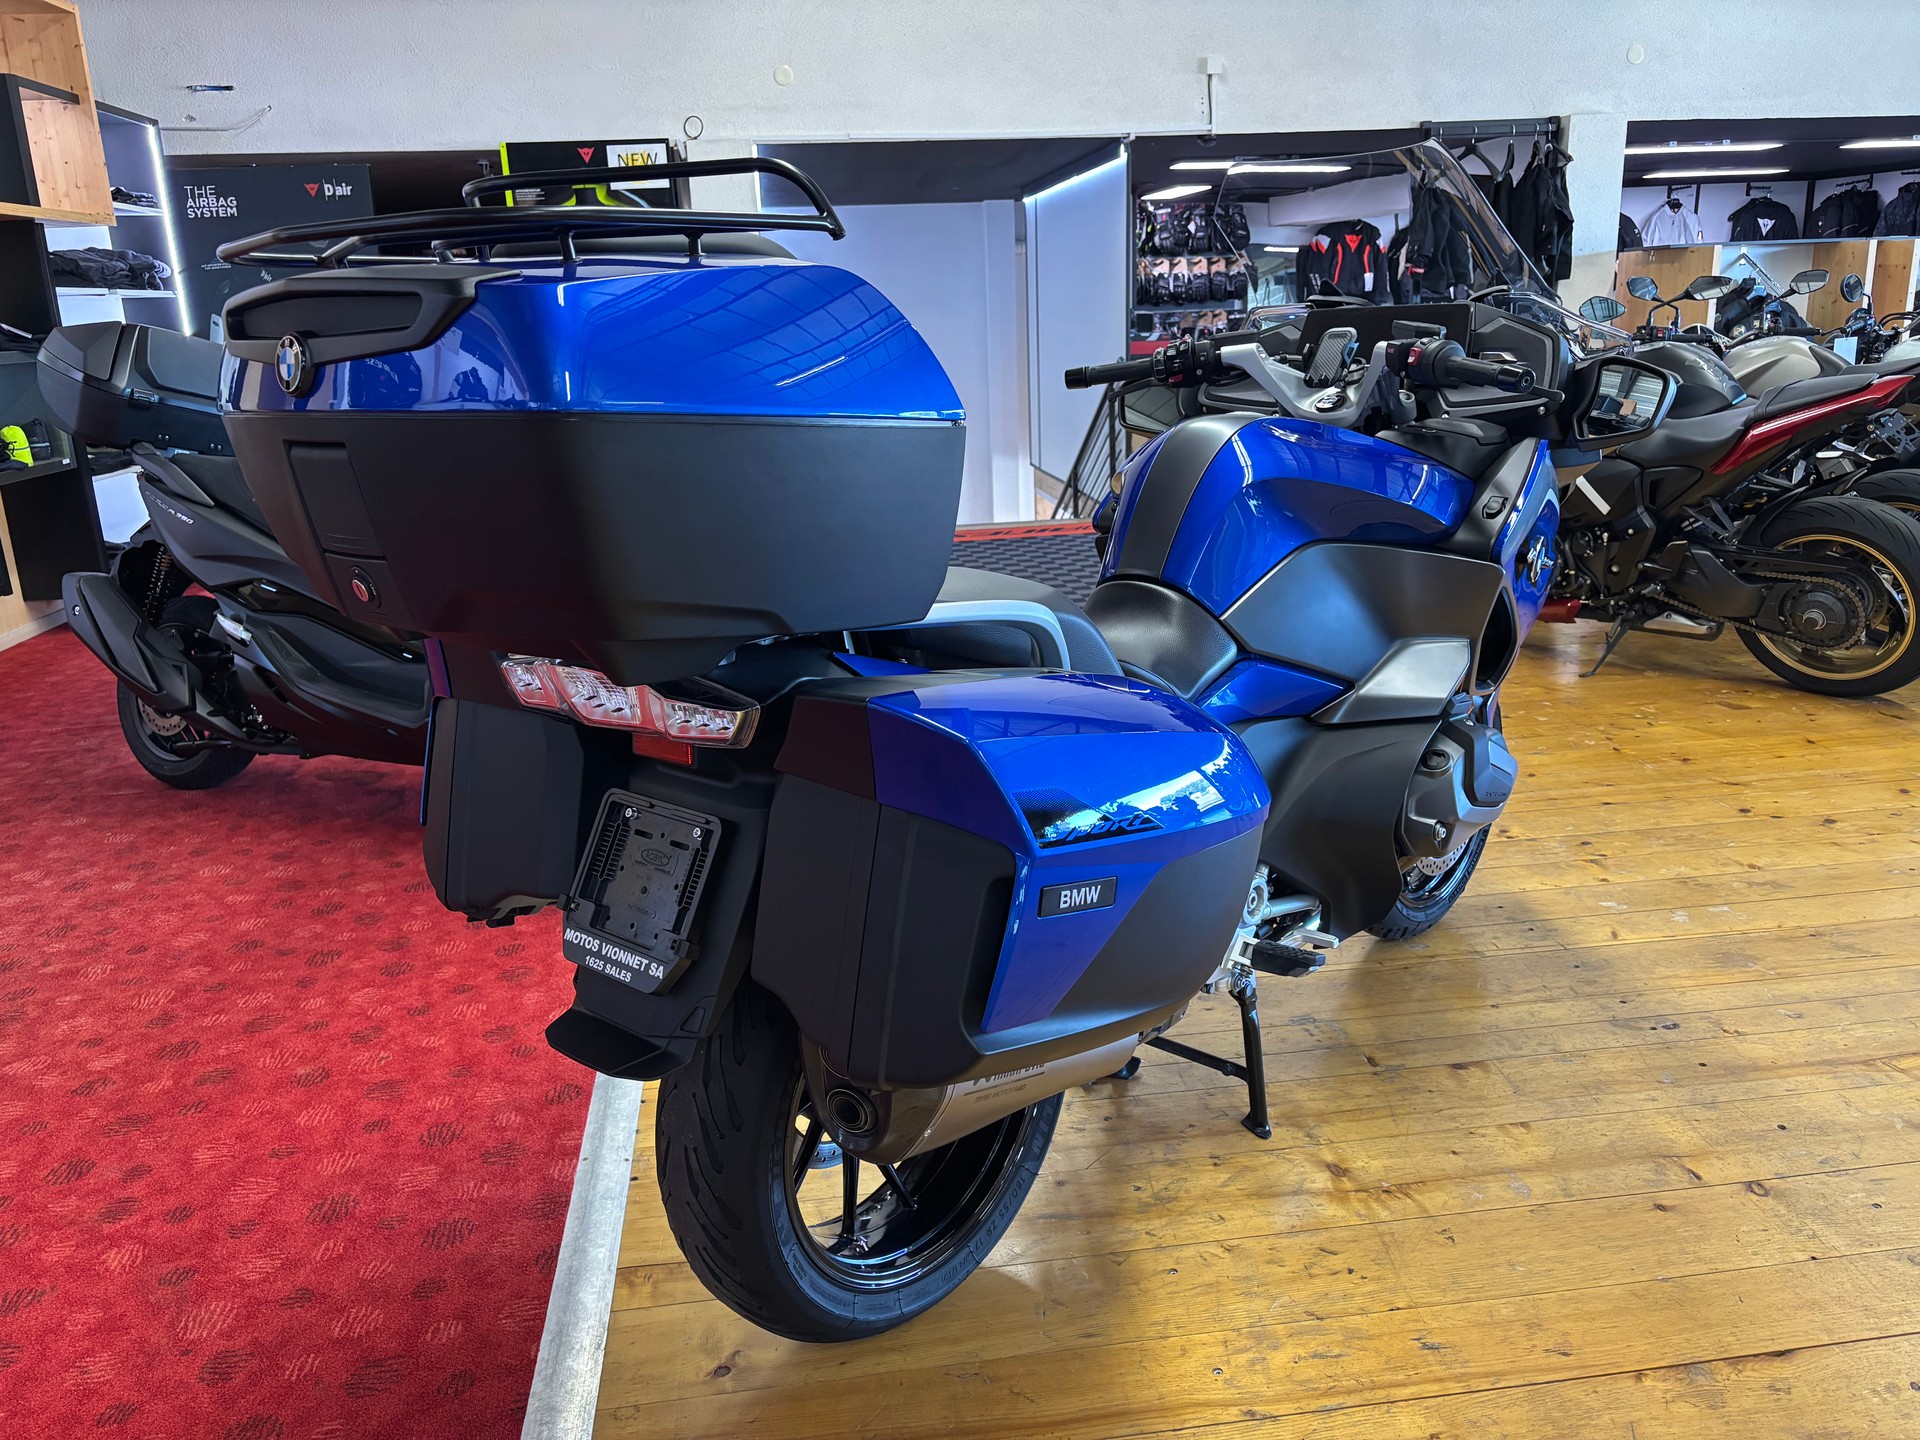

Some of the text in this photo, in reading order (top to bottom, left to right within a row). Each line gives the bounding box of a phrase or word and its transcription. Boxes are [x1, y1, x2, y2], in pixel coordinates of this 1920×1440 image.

[184, 185, 217, 198] THE
[186, 197, 237, 208] AIRBAG
[187, 207, 238, 218] SYSTEM
[1059, 885, 1102, 909] BMW
[563, 928, 664, 980] MOTOS VIONNET SA
[585, 955, 632, 983] 1625 SALES
[999, 1175, 1026, 1220] 180/55
